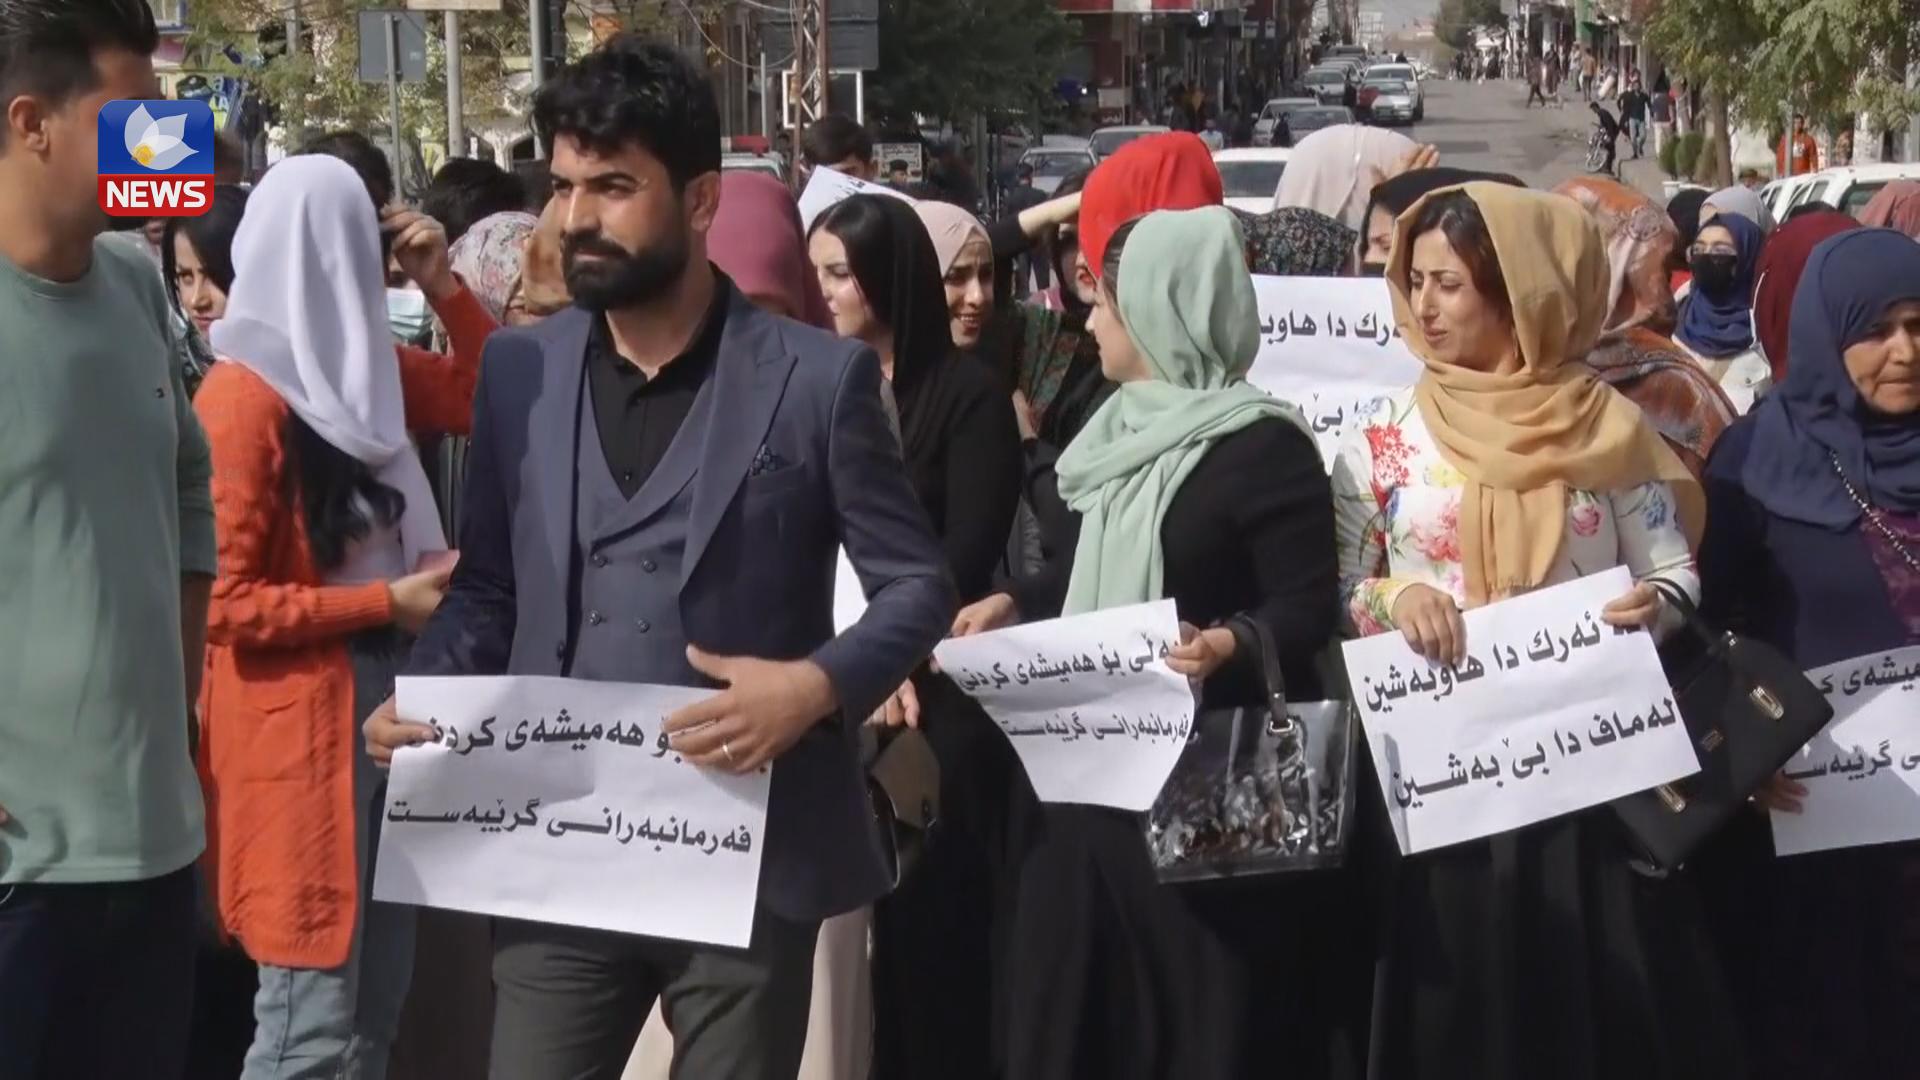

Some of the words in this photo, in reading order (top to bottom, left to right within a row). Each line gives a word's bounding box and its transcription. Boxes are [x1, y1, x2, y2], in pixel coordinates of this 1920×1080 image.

[1261, 310, 1317, 344] هاوب
[1327, 312, 1346, 338] دا
[1493, 643, 1520, 671] دا
[1554, 730, 1581, 758] دا
[1393, 753, 1503, 808] بەشین
